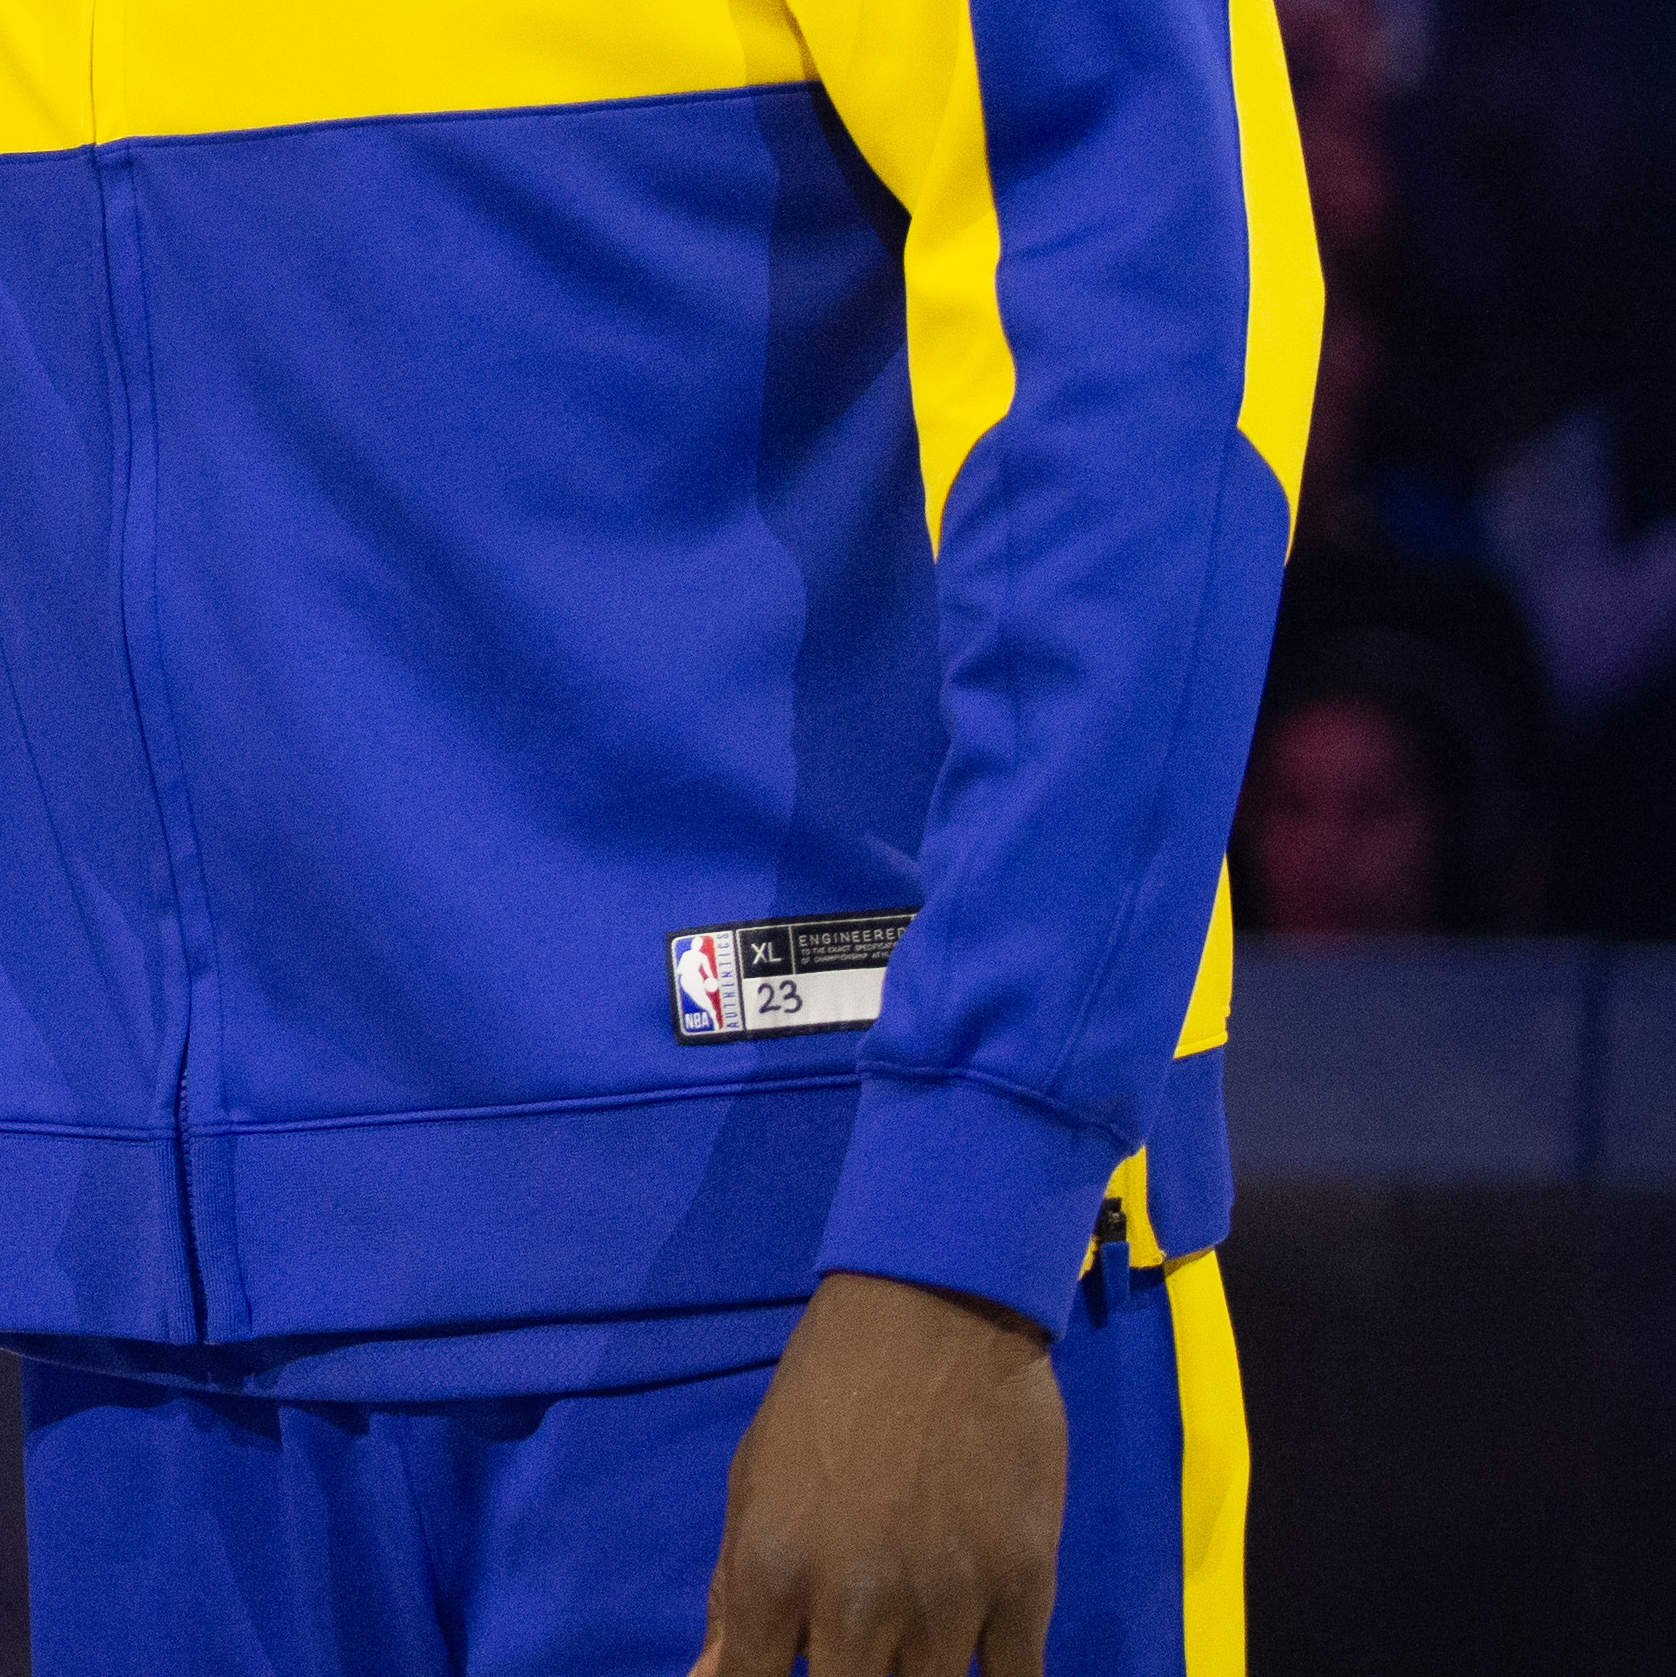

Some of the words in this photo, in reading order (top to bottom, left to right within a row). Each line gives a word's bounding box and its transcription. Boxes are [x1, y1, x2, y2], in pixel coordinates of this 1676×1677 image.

[751, 942, 783, 965] XL
[716, 932, 740, 1029] AUTHENTICS
[757, 979, 804, 1014] 23
[684, 1011, 710, 1030] NBA
